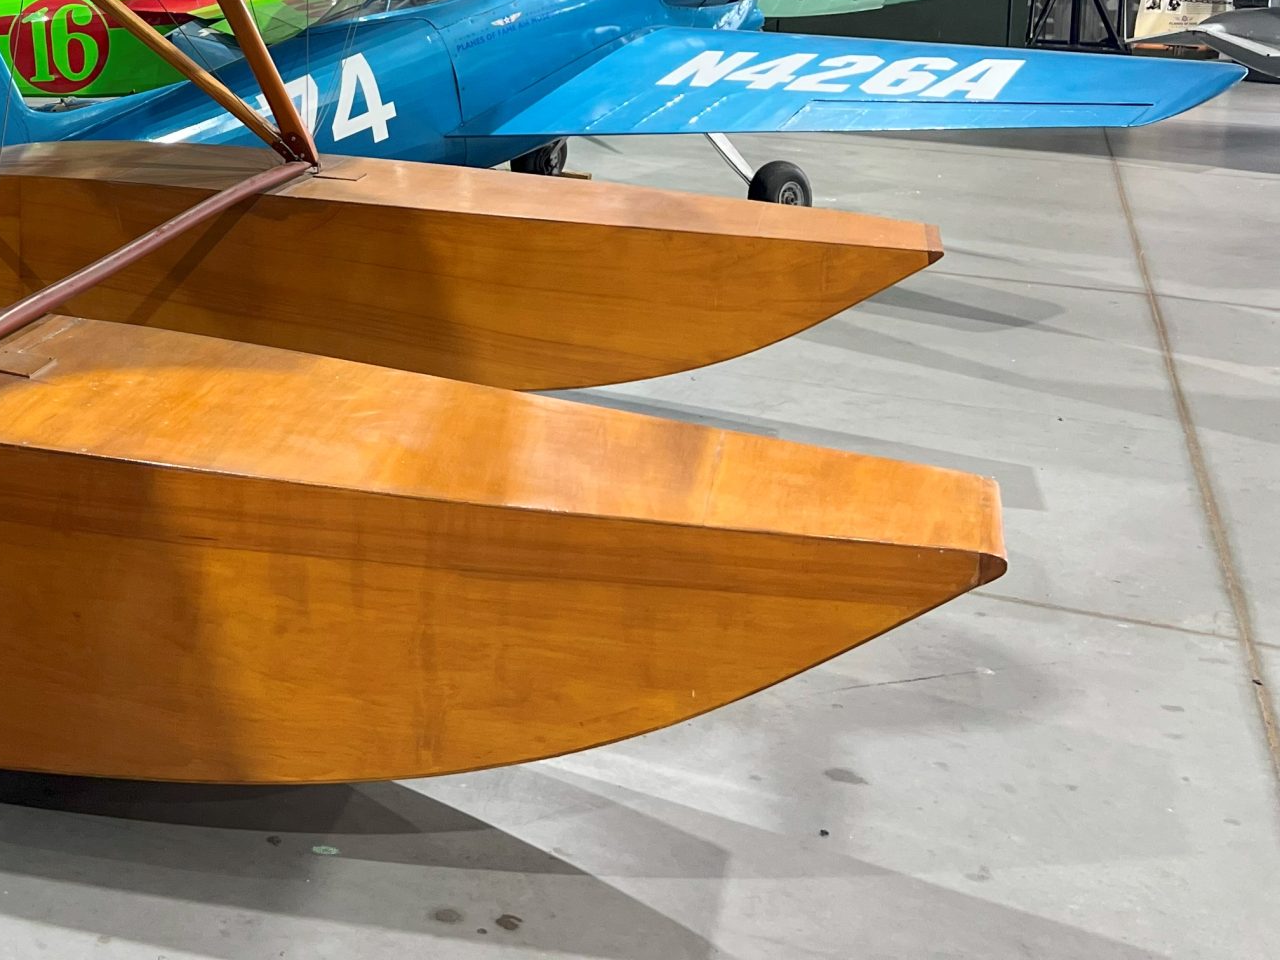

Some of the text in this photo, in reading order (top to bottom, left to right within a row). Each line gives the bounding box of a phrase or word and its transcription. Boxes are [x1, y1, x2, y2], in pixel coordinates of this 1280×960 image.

[22, 3, 99, 82] 16
[457, 36, 486, 52] PLANES
[655, 50, 1026, 100] N426A
